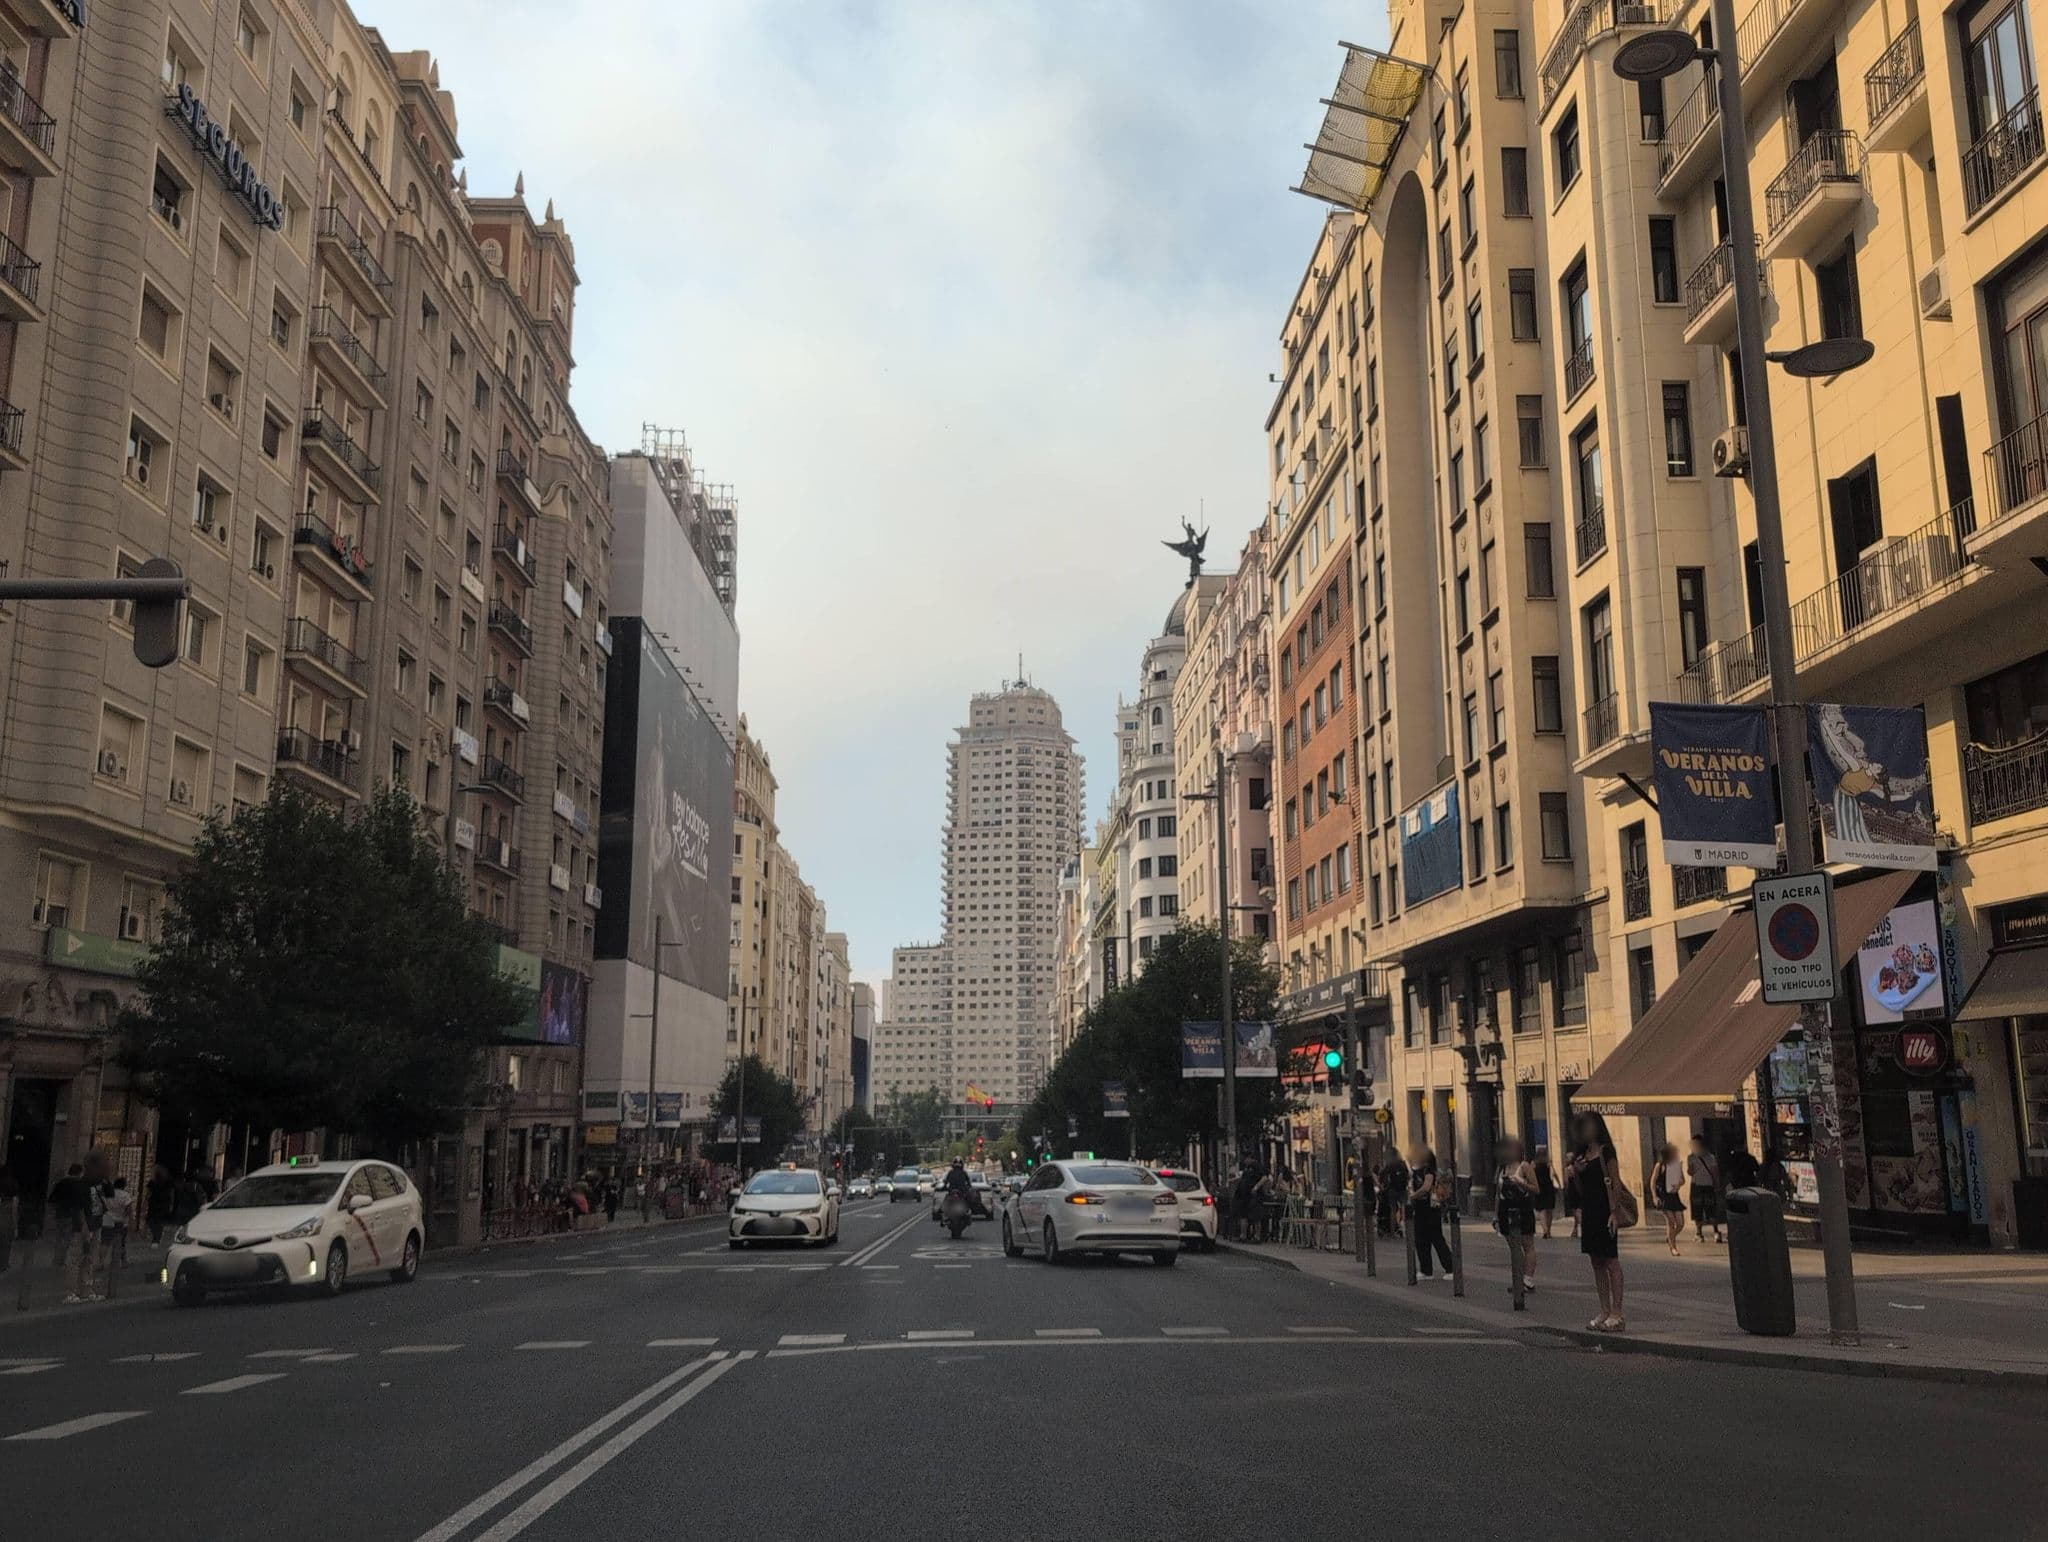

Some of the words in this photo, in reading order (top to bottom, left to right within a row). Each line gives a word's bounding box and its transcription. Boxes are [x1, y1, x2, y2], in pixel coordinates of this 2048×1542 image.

[179, 82, 285, 232] SEGUROS
[1659, 748, 1765, 772] VERANOS
[1701, 771, 1716, 780] DE
[1716, 771, 1729, 780] LA
[1685, 774, 1753, 799] VILLA
[1708, 850, 1749, 861] MADRID
[1845, 850, 1916, 864] veranosdelavilla.com
[1759, 891, 1775, 902] EN
[1782, 885, 1821, 900] ACERA
[1773, 966, 1797, 976] TODO
[1802, 964, 1822, 973] TIPO
[1766, 982, 1777, 992] DE
[1781, 978, 1832, 991] VEHÍCULOS
[1906, 1038, 1935, 1063] illy
